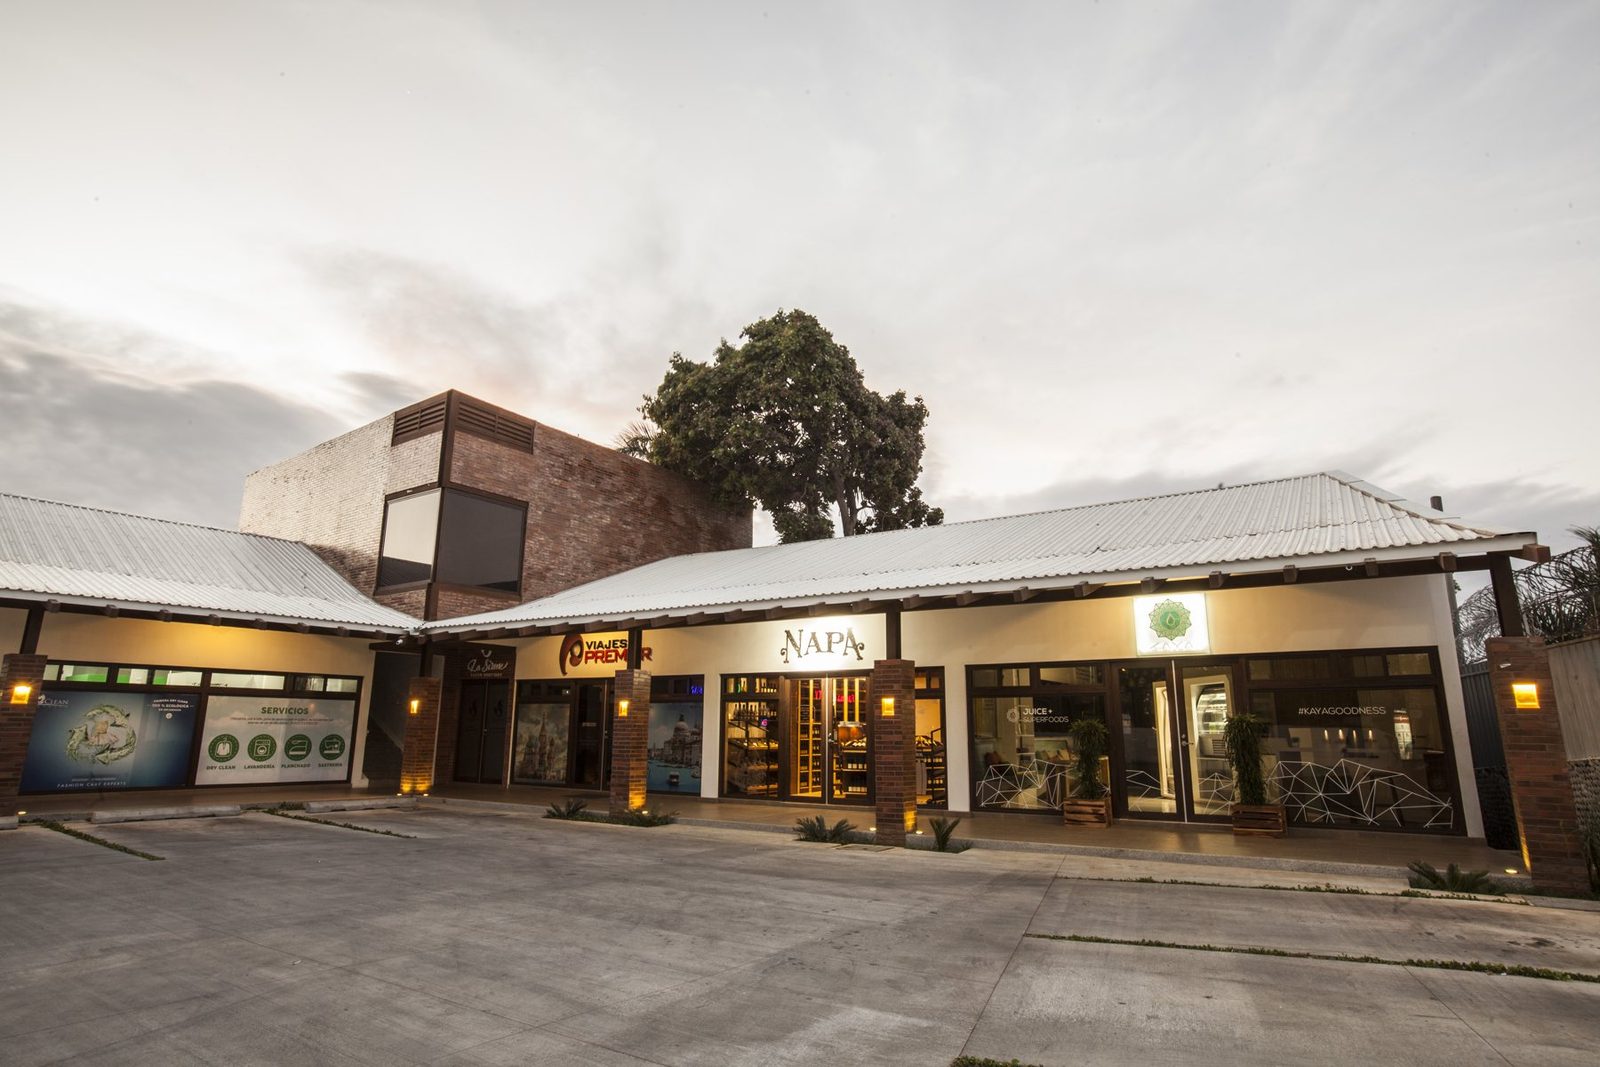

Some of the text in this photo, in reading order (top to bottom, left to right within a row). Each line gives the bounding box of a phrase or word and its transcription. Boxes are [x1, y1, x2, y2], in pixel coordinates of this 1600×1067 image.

[585, 639, 628, 650] VIAJES
[780, 627, 865, 664] NAPA
[584, 647, 652, 665] PREMR
[261, 706, 310, 716] SERVICIOS
[1298, 706, 1386, 716] #KAYAGOODNESS
